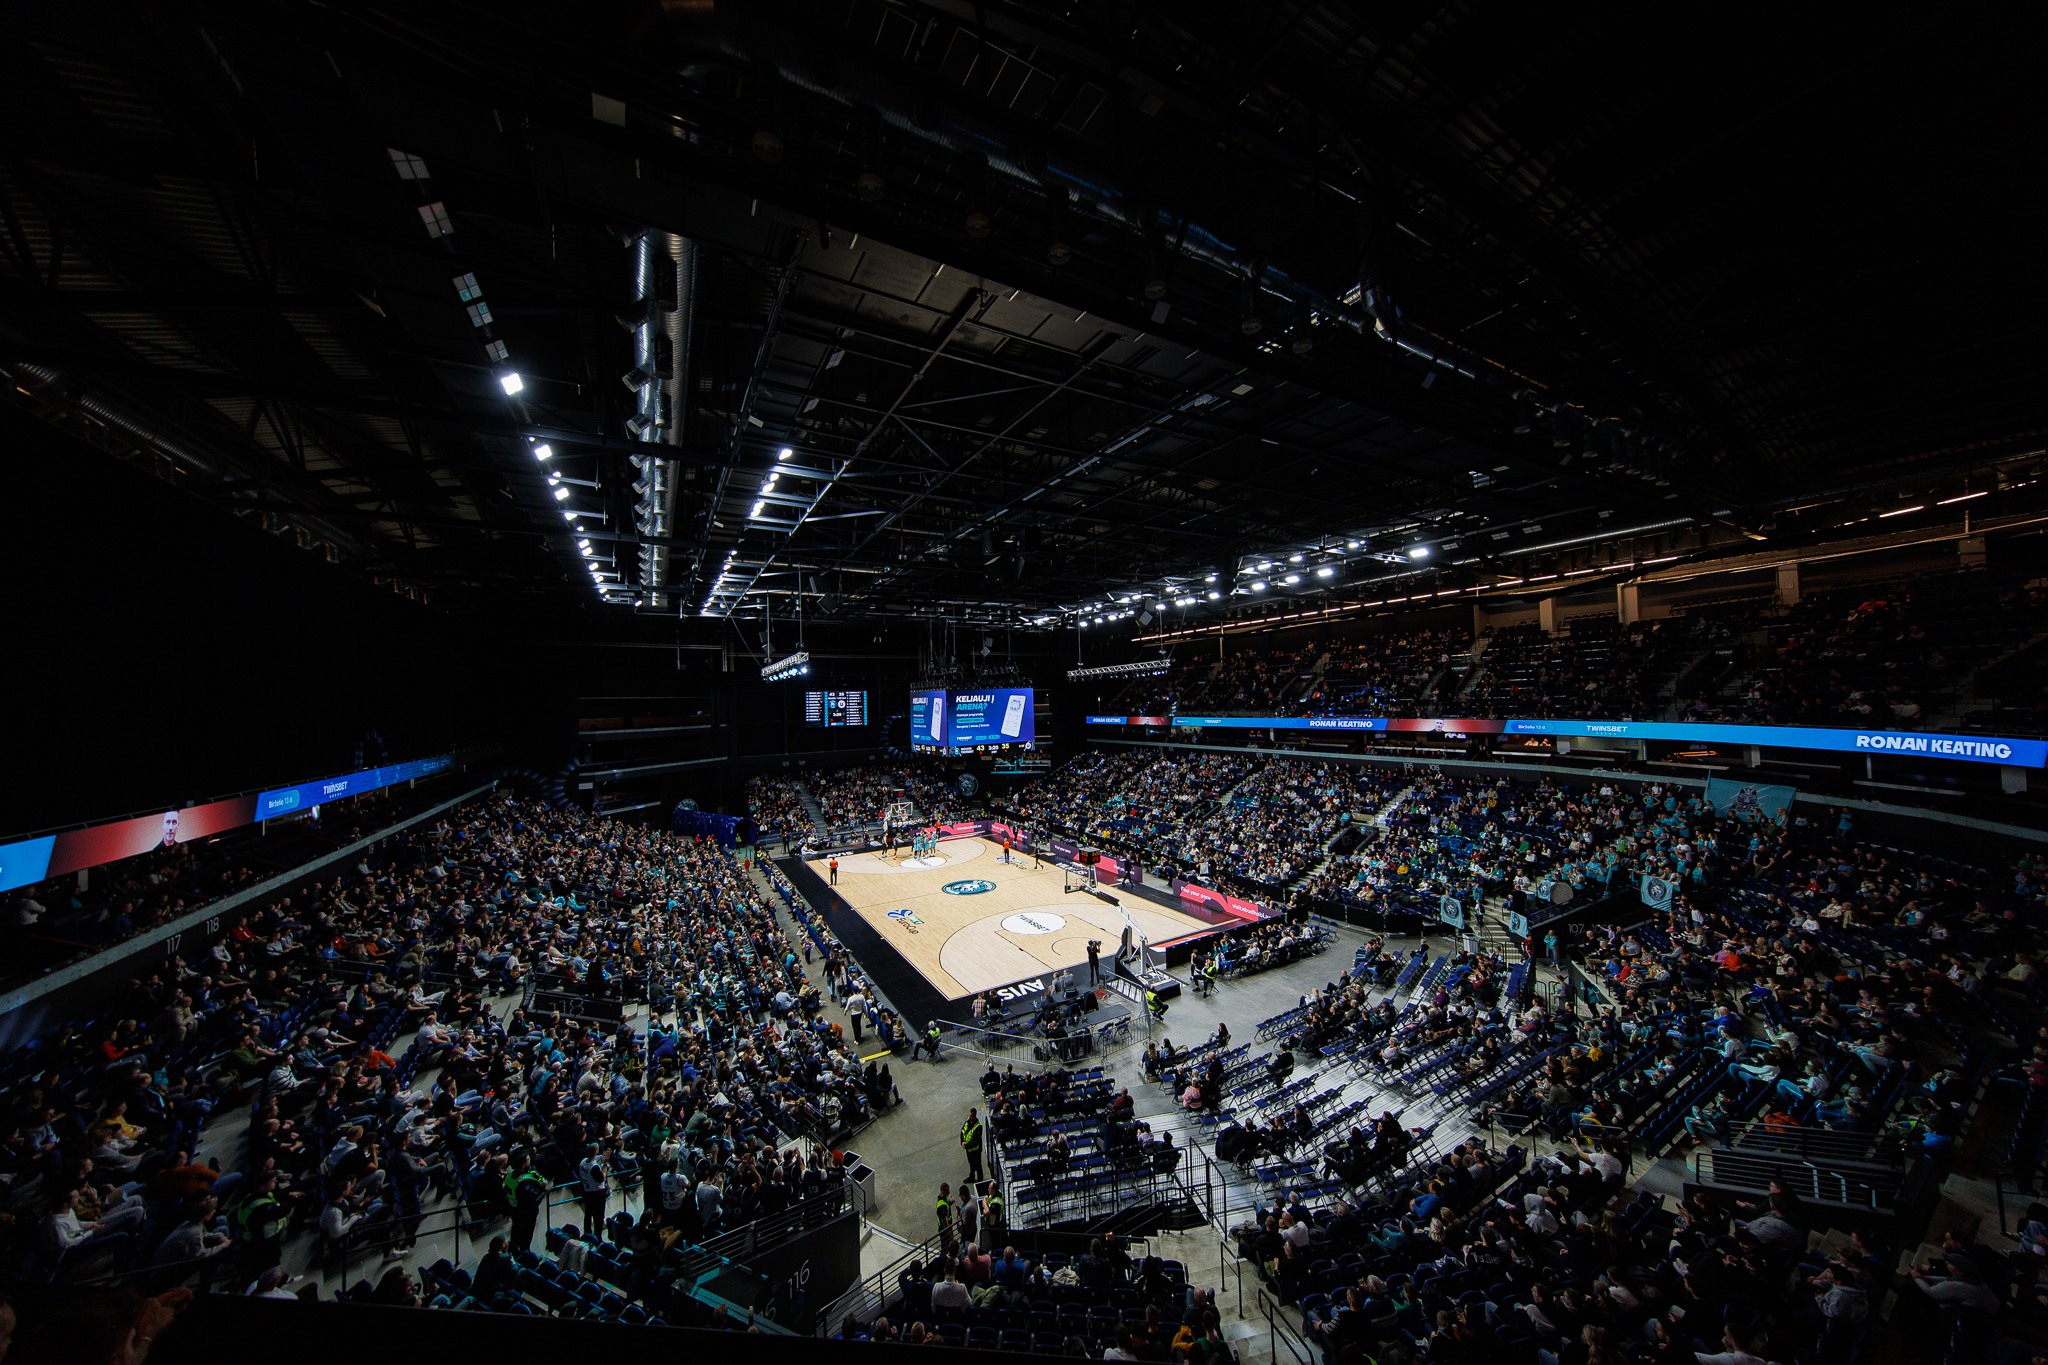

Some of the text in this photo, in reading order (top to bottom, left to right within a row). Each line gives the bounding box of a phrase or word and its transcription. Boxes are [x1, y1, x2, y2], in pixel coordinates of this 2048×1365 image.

[956, 695, 991, 703] KELIAUJI
[956, 702, 988, 712] ARENĄ?
[1337, 720, 1373, 728] KEATING
[1586, 725, 1628, 733] TWINSBET
[1856, 735, 2012, 759] RONAN KEATING
[323, 782, 348, 795] TWINSBET
[268, 799, 284, 809] Birželio
[1200, 893, 1211, 901] pace
[206, 917, 220, 935] 118
[1568, 923, 1585, 934] 107
[166, 934, 181, 955] 117
[997, 979, 1045, 1001] AVIS
[662, 1191, 676, 1201] 23
[787, 1259, 810, 1299] 116
